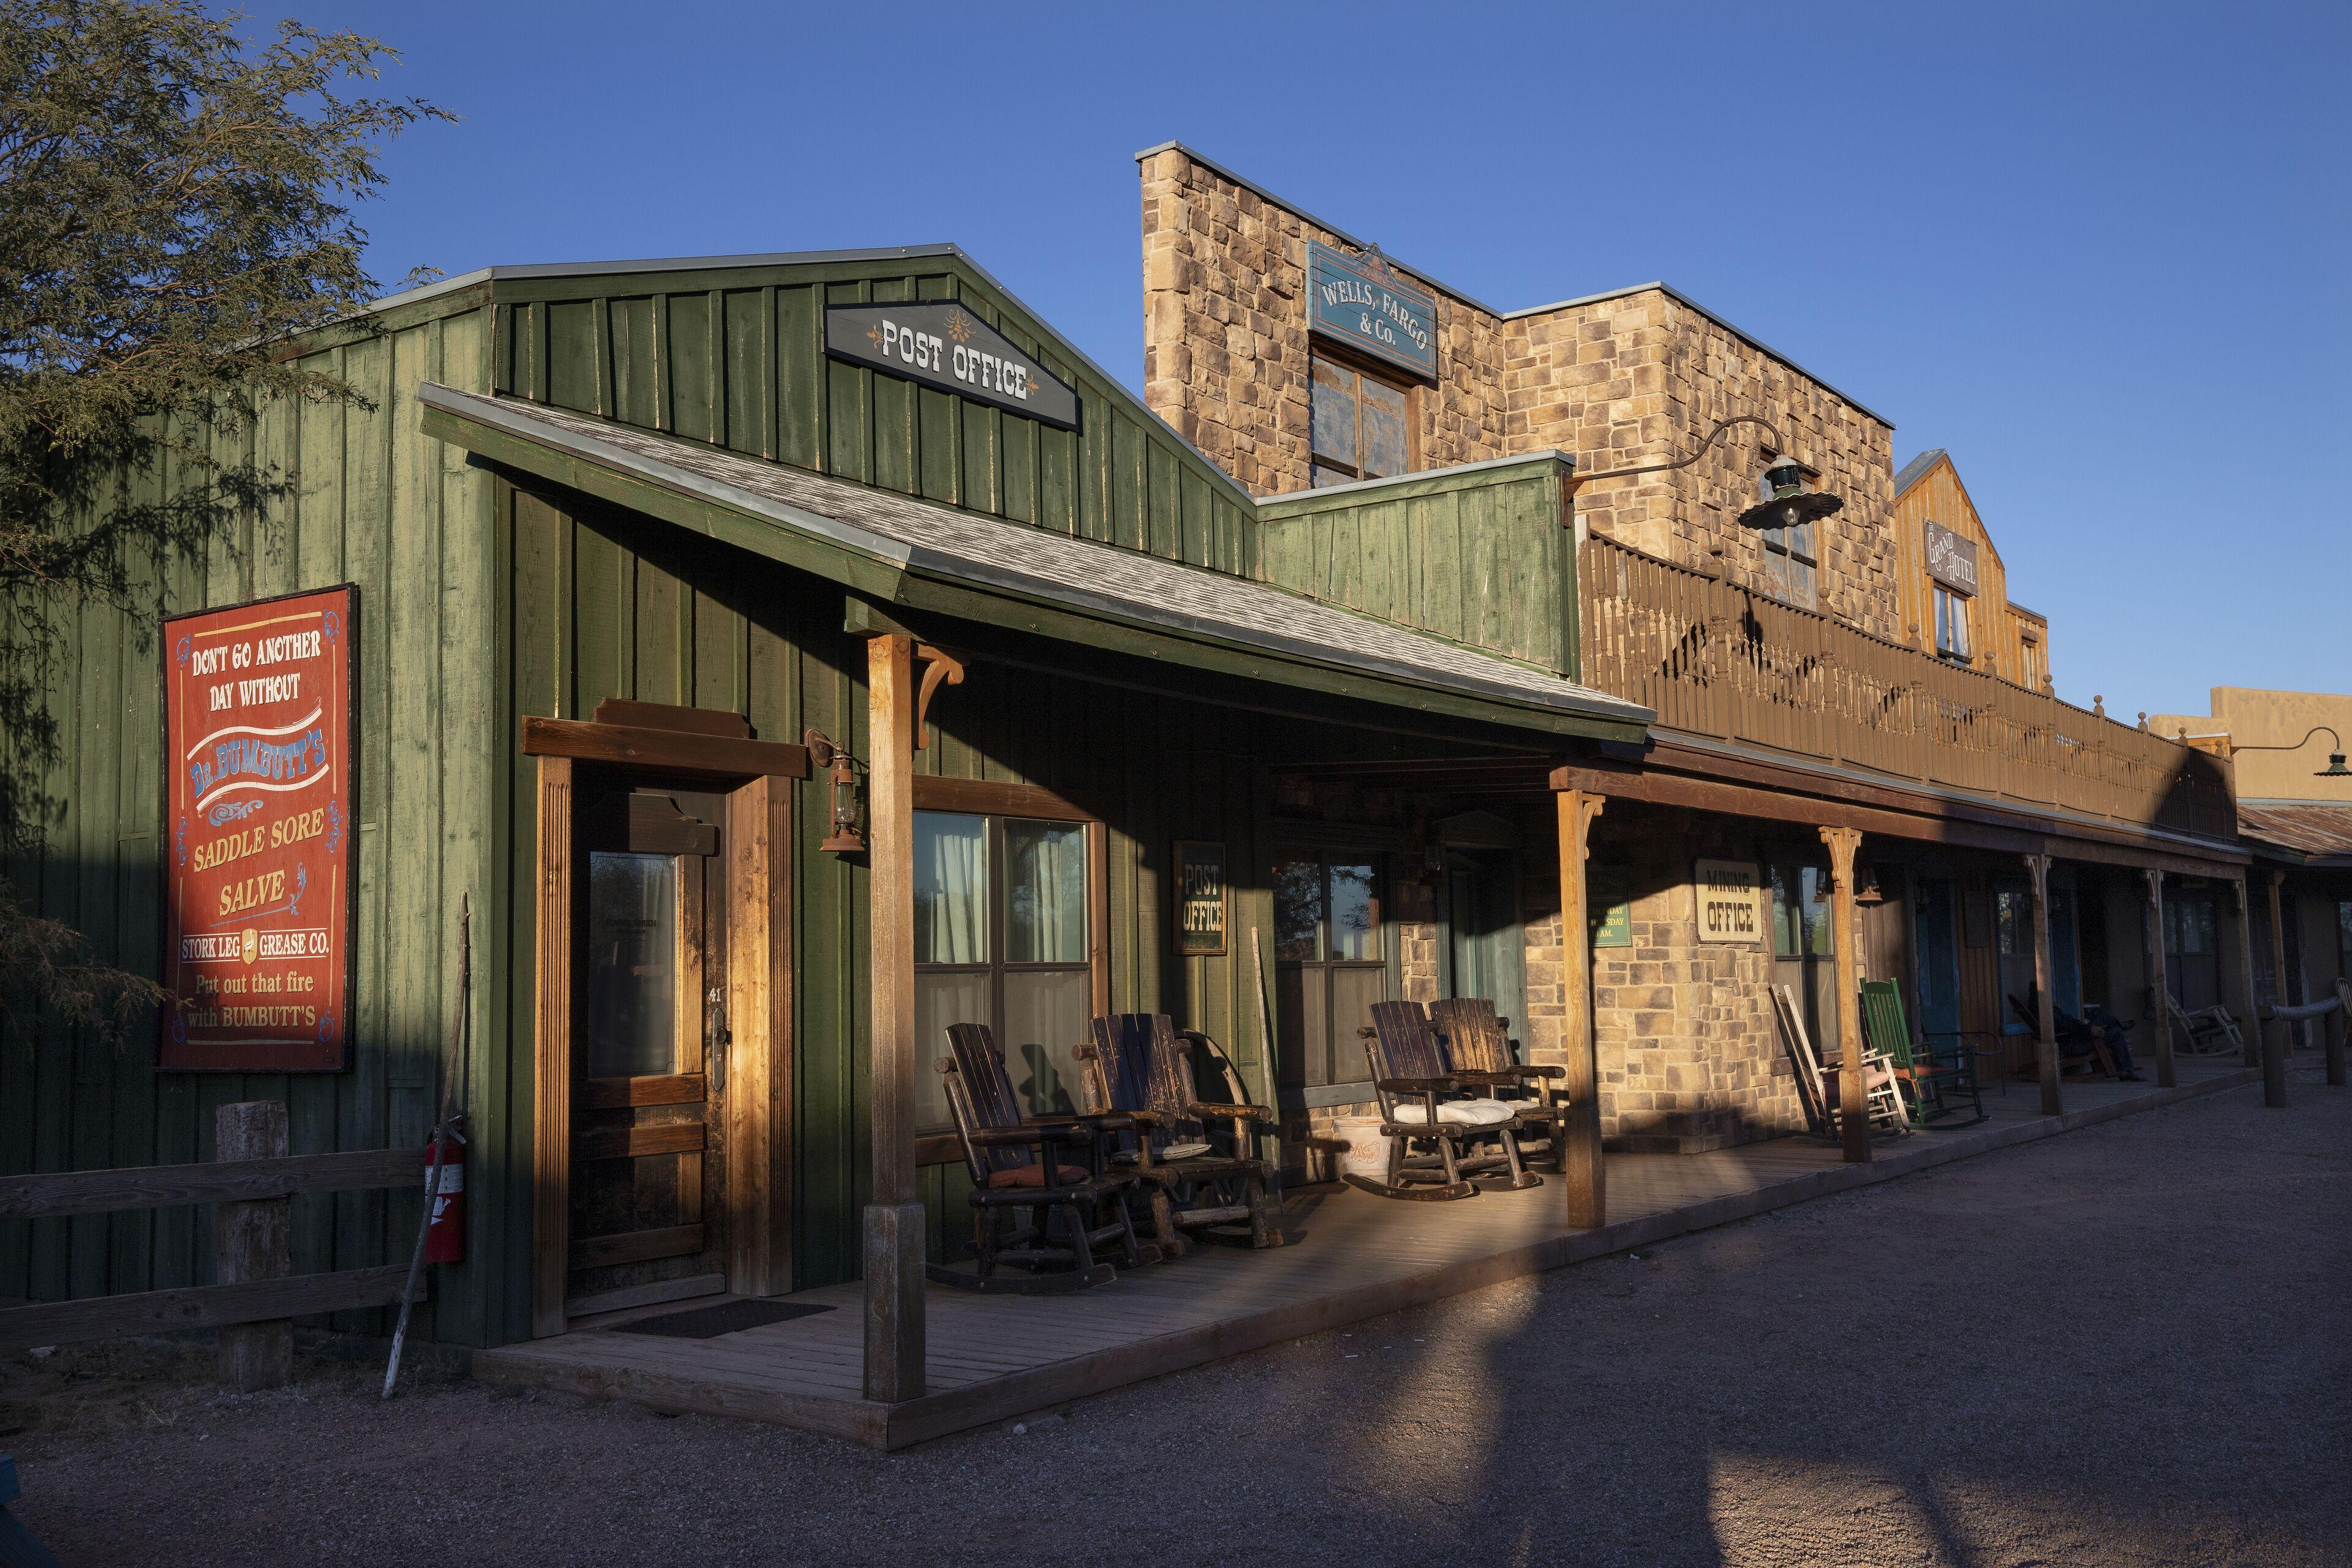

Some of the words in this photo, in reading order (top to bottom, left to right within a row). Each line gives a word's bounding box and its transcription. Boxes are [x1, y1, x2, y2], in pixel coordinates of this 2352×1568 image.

[1322, 281, 1376, 311] WELLS,
[1382, 293, 1427, 350] FARGO
[1360, 312, 1372, 336] &
[881, 319, 943, 372] POST
[952, 344, 1027, 401] OFFICE
[1928, 532, 1953, 572] GRAND
[1947, 551, 1976, 585] HOTEL
[192, 645, 228, 676] DON'T
[232, 643, 252, 668] GO
[256, 630, 321, 665] ANOTHER
[209, 681, 234, 712] DAY
[238, 673, 300, 707] WITHOUT
[194, 826, 266, 873] SADDLE
[270, 808, 325, 849] SORE
[219, 869, 285, 917] SALVE
[1185, 864, 1219, 895] POST
[1707, 870, 1751, 894] MINING
[1183, 901, 1223, 931] OFFICE
[1708, 901, 1754, 932] OFFICE
[182, 936, 216, 960] STORK
[218, 935, 240, 958] LEG
[259, 933, 306, 956] GREASE
[309, 932, 329, 954] CO.
[195, 974, 219, 995] Put
[224, 974, 247, 994] out
[252, 971, 285, 993] that
[287, 971, 314, 993] fire
[709, 988, 720, 1002] 41
[187, 1007, 218, 1028] with
[222, 1005, 316, 1028] BUMBUTT'S
